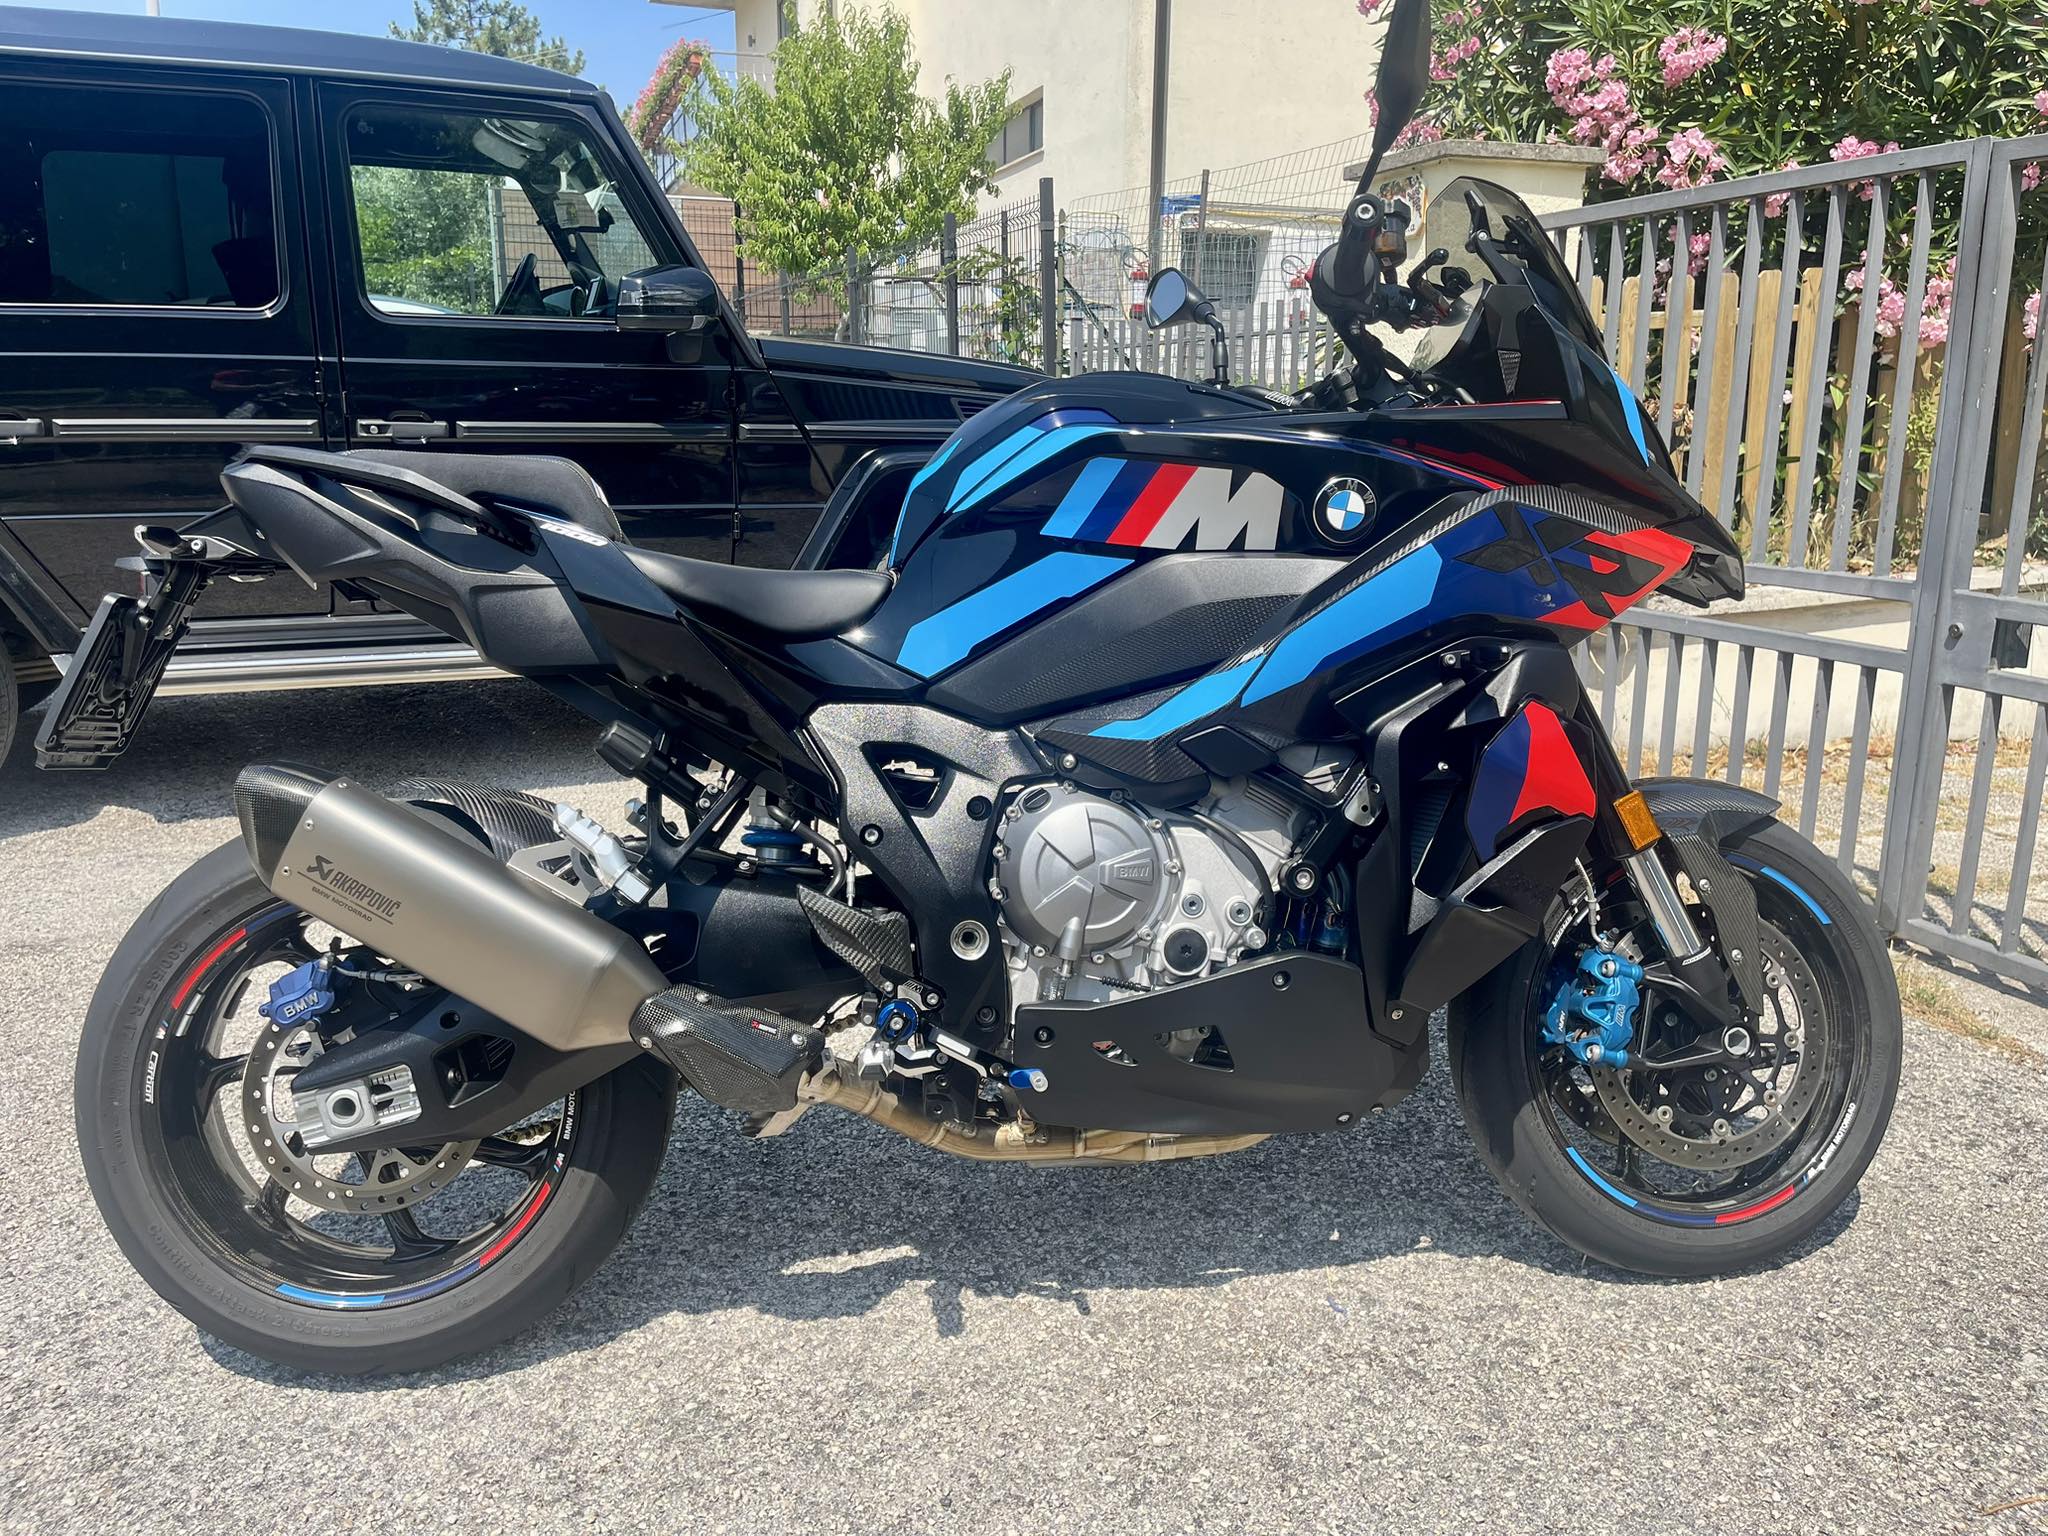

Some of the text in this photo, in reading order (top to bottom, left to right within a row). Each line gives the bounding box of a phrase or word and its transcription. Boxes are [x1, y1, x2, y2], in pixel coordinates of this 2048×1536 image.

[1141, 466, 1285, 550] M
[540, 522, 608, 547] 1000
[1119, 866, 1149, 877] BMW
[311, 886, 372, 922] BMW MOTORRAD
[284, 991, 319, 1018] BMW
[145, 1050, 159, 1105] Carbon
[563, 1117, 574, 1141] BMW
